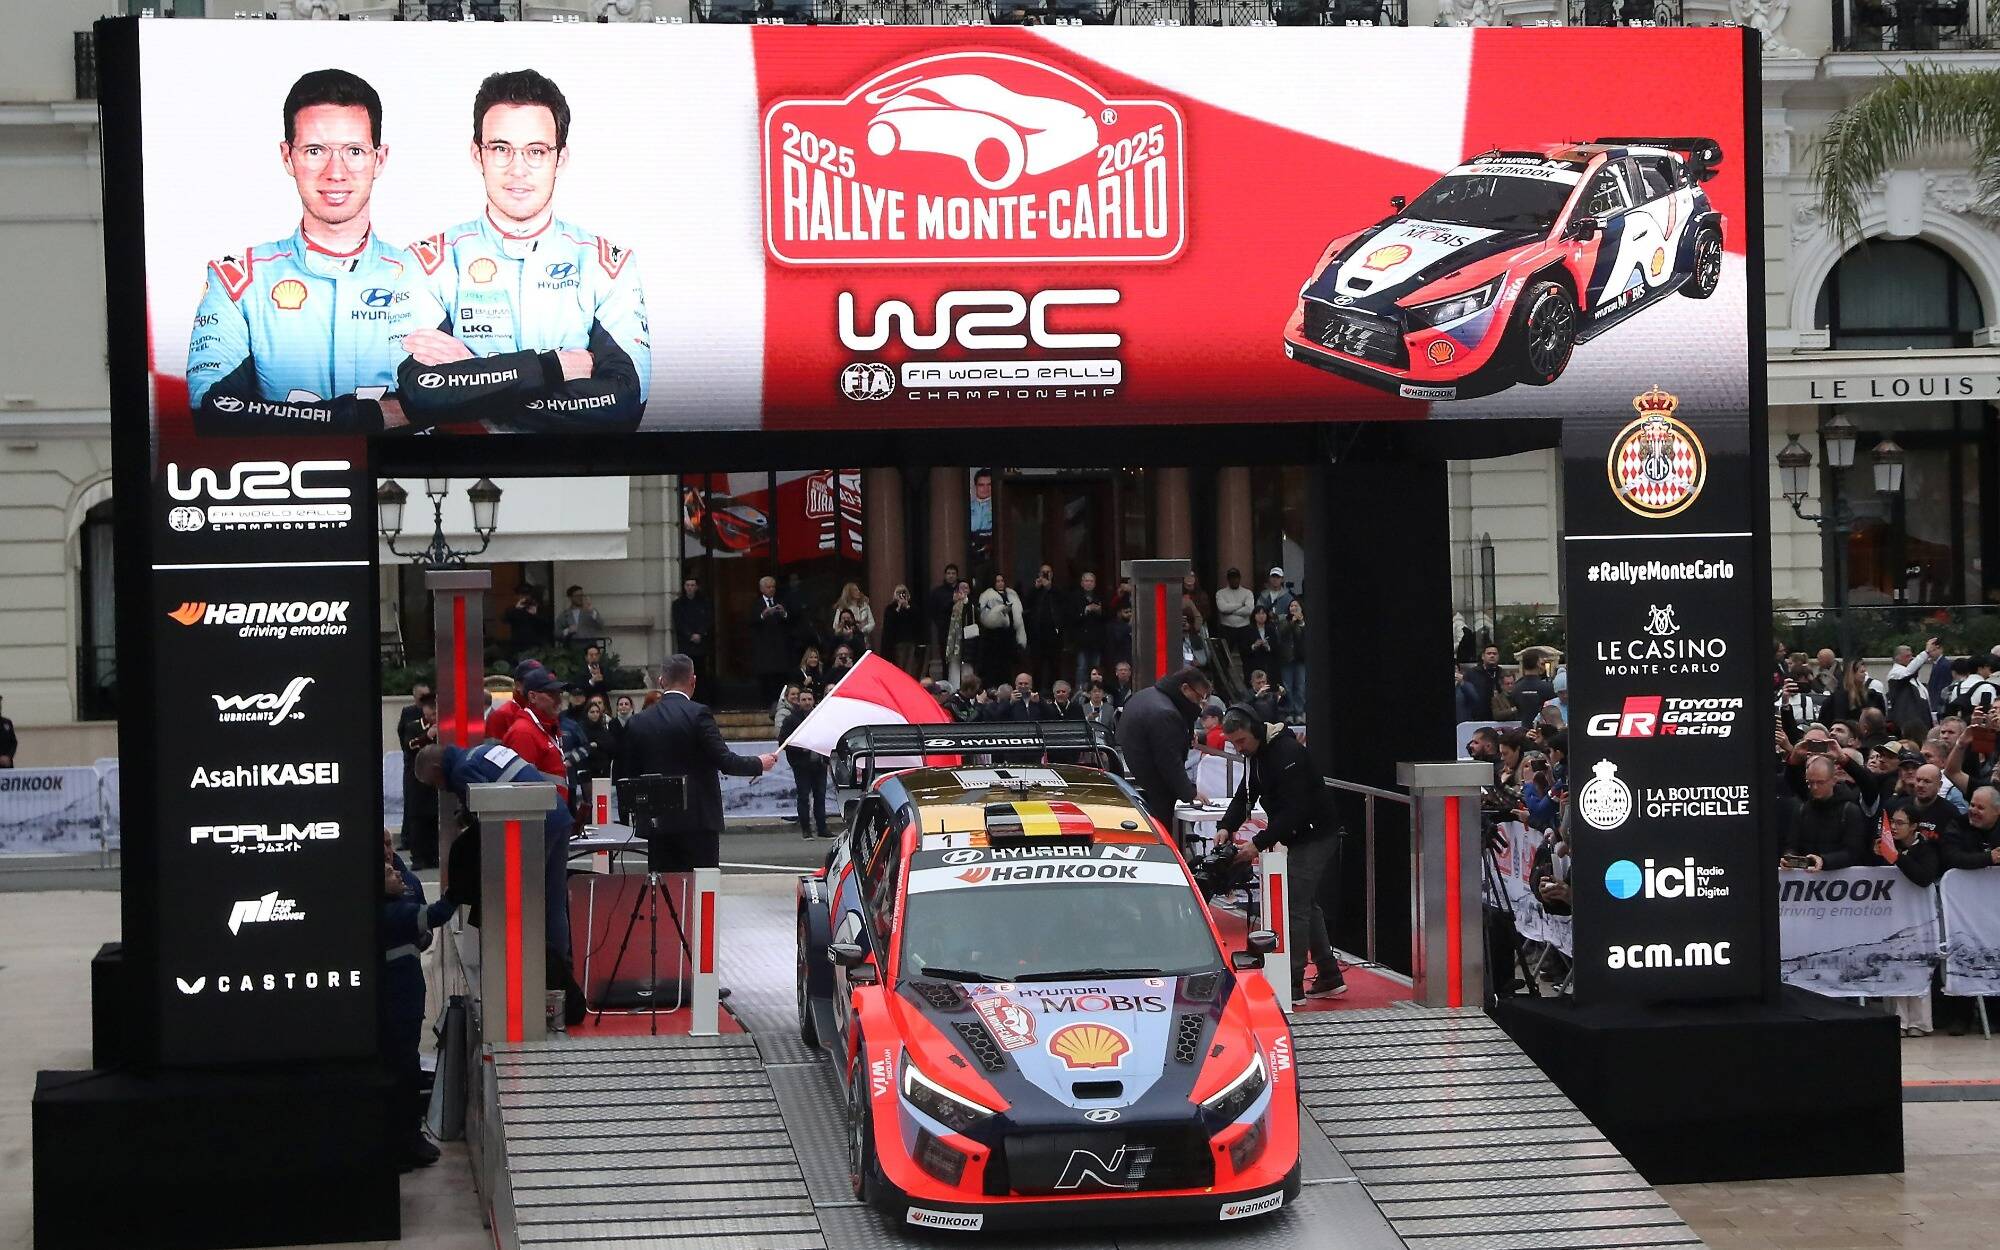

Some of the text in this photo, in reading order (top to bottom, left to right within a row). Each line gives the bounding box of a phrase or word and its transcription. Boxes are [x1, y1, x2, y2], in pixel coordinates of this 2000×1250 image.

[782, 122, 855, 178] 2025
[1097, 124, 1164, 177] 2025
[783, 154, 1168, 241] RALLYE MONTE-CARLO
[1400, 228, 1470, 247] MOBIS
[462, 324, 493, 333] LKQ
[838, 289, 1121, 351] WRC
[448, 368, 518, 387] HYUNDAI
[908, 367, 1115, 380] FIA WORLD RALLY
[908, 388, 1115, 400] CHAMPIONSHIP
[1810, 380, 1847, 399] LE
[1871, 377, 1973, 397] LOUIS
[547, 393, 616, 412] HYUNDAI
[248, 401, 332, 423] HYUNDAI
[167, 460, 351, 501] WRC
[212, 521, 348, 531] CHAMPIONSHIP
[1588, 559, 1734, 585] #RallyeMonteCarlo
[239, 623, 347, 639] driving emotion
[1597, 638, 1727, 661] LE CASINO
[1665, 697, 1743, 710] TOYOTA
[219, 711, 274, 722] LUBRICANTS
[1586, 713, 1656, 737] GR
[1662, 711, 1735, 723] GAZOO
[1660, 723, 1732, 738] Racing
[961, 738, 1040, 746] HYUNDAI
[1647, 785, 1750, 803] LA BOUTIQUE
[1646, 800, 1750, 818] OFFICIELLE
[190, 822, 340, 844] FORUM8
[942, 834, 952, 848] 1
[230, 841, 302, 854] フォーラムエイト
[1644, 857, 1695, 899] ici
[1696, 866, 1725, 876] Radio
[1697, 876, 1710, 886] TV
[1697, 886, 1730, 899] Digital
[1830, 904, 1893, 917] emotion
[1607, 941, 1731, 969] acm.mc
[218, 970, 361, 992] CASTORE
[1018, 987, 1107, 998] HYUNDAI
[1041, 995, 1168, 1013] MOBIS
